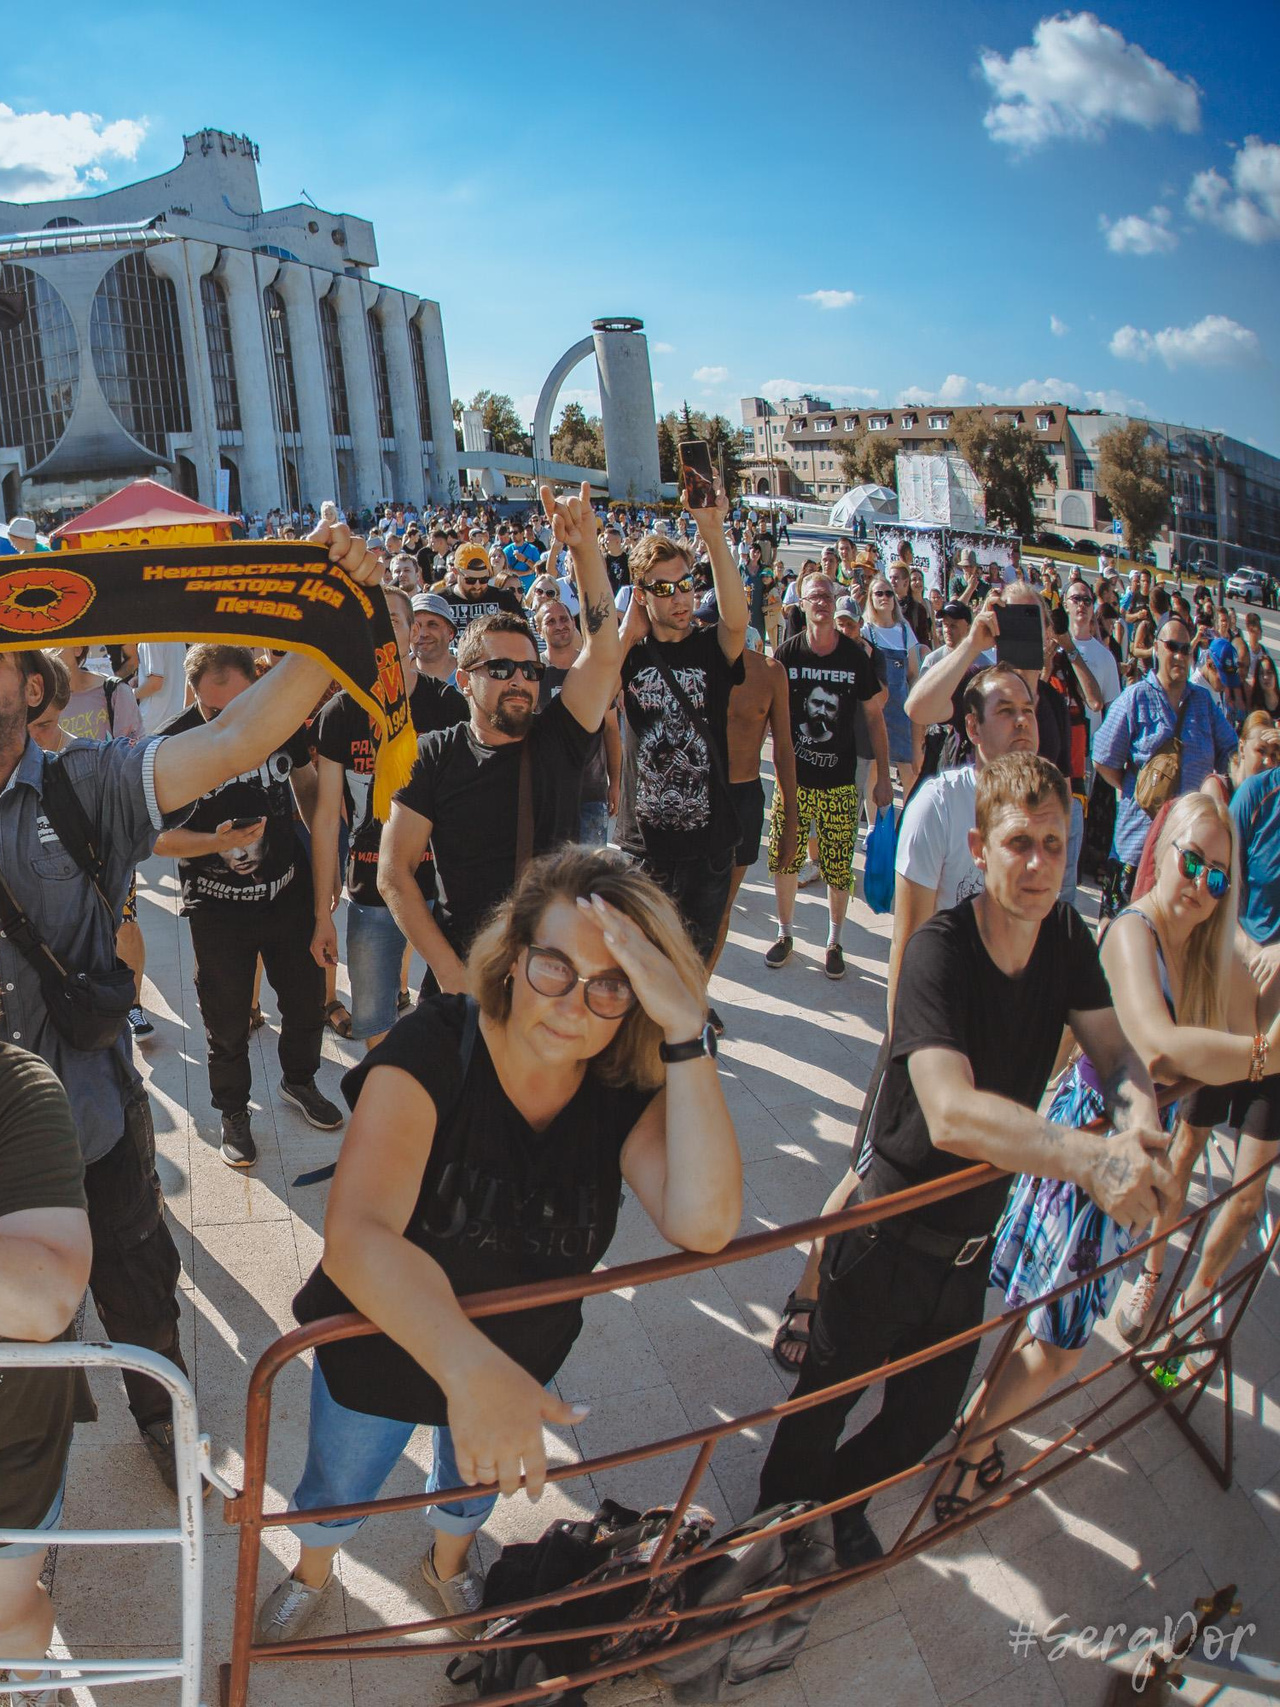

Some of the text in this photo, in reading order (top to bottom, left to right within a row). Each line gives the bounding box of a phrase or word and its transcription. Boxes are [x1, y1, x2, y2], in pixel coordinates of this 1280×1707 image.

[142, 562, 328, 580] Неизвестные
[184, 578, 345, 609] Виктора Цоя
[215, 596, 303, 621] Печаль
[788, 667, 856, 684] В ПИТЕРЕ
